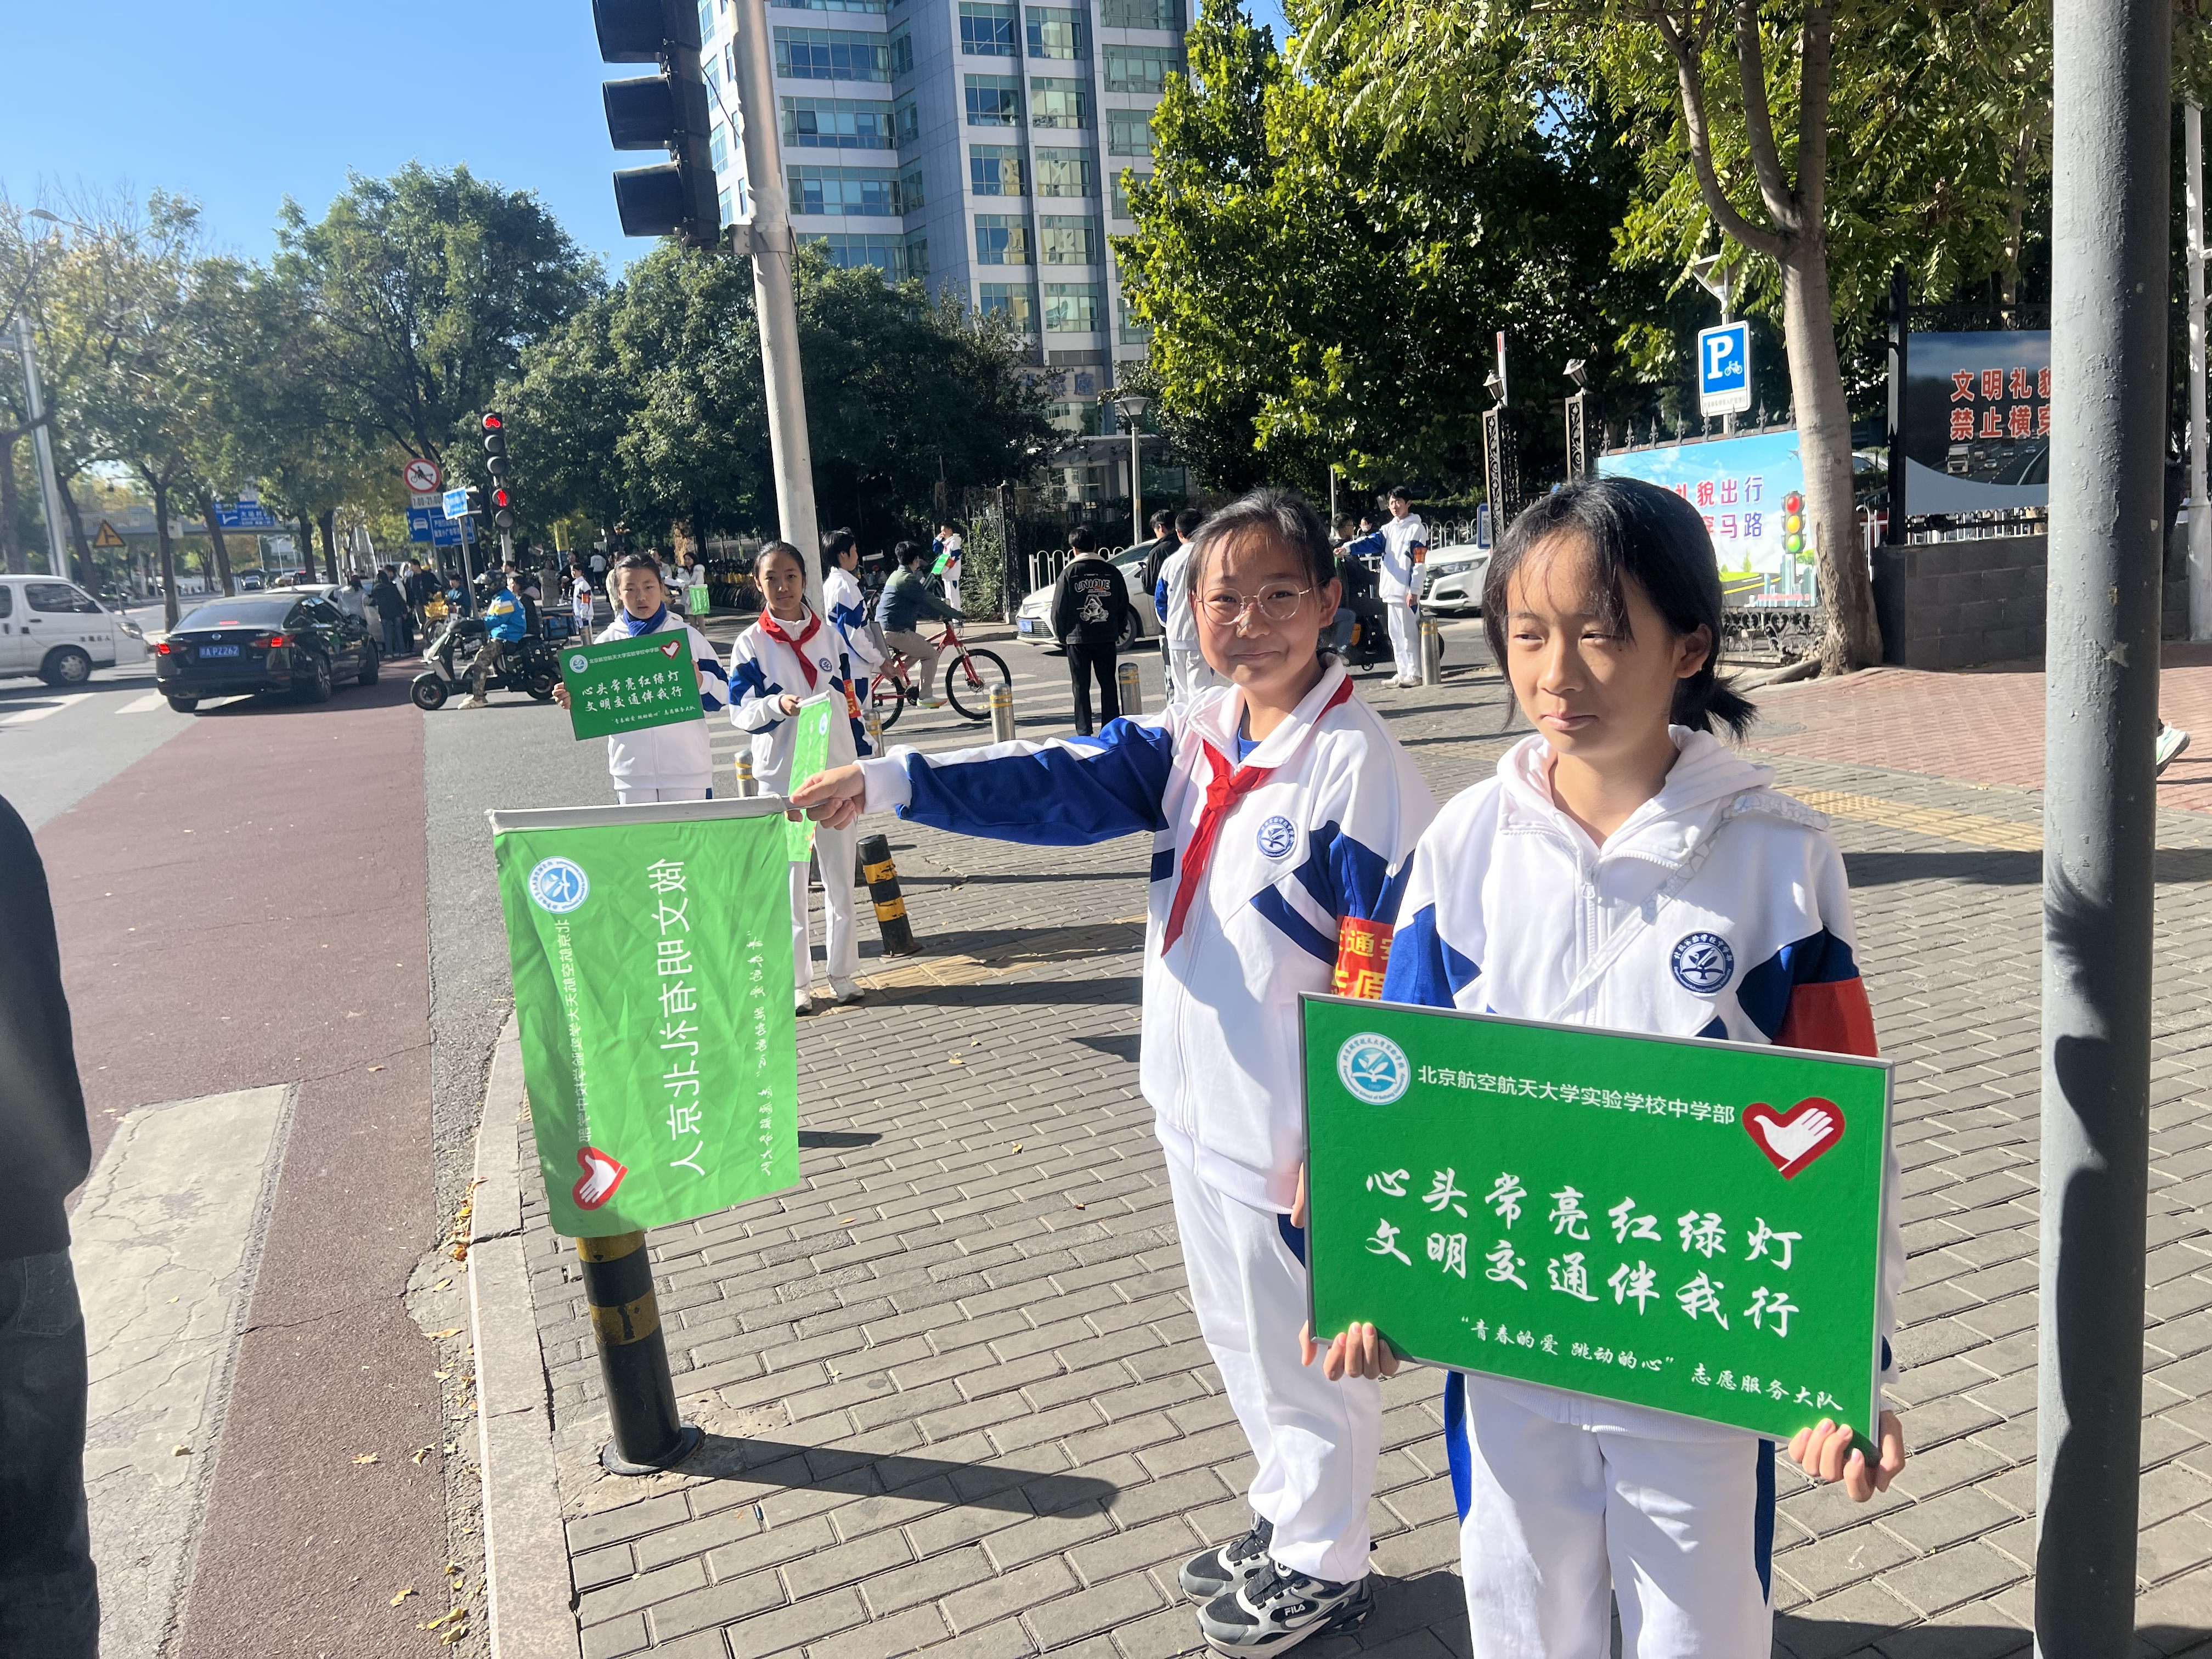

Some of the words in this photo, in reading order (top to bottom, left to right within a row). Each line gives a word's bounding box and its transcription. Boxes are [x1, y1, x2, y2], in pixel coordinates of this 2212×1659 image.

[1707, 335, 1734, 380] P
[1660, 476, 1763, 506] 礼貌出行
[1074, 579, 1110, 592] UNIQUE
[582, 670, 679, 696] 心头常亮红绿灯
[585, 686, 682, 712] 文明交通伴我行
[1418, 1065, 1735, 1125] 北京航空航天大学实验学校中学部
[1366, 1167, 1803, 1271] 心头常亮红绿灯
[1365, 1218, 1799, 1338] 文明交通伴我行
[1691, 1362, 1843, 1411] 志愿服务大队
[1284, 1604, 1306, 1616] FILA
